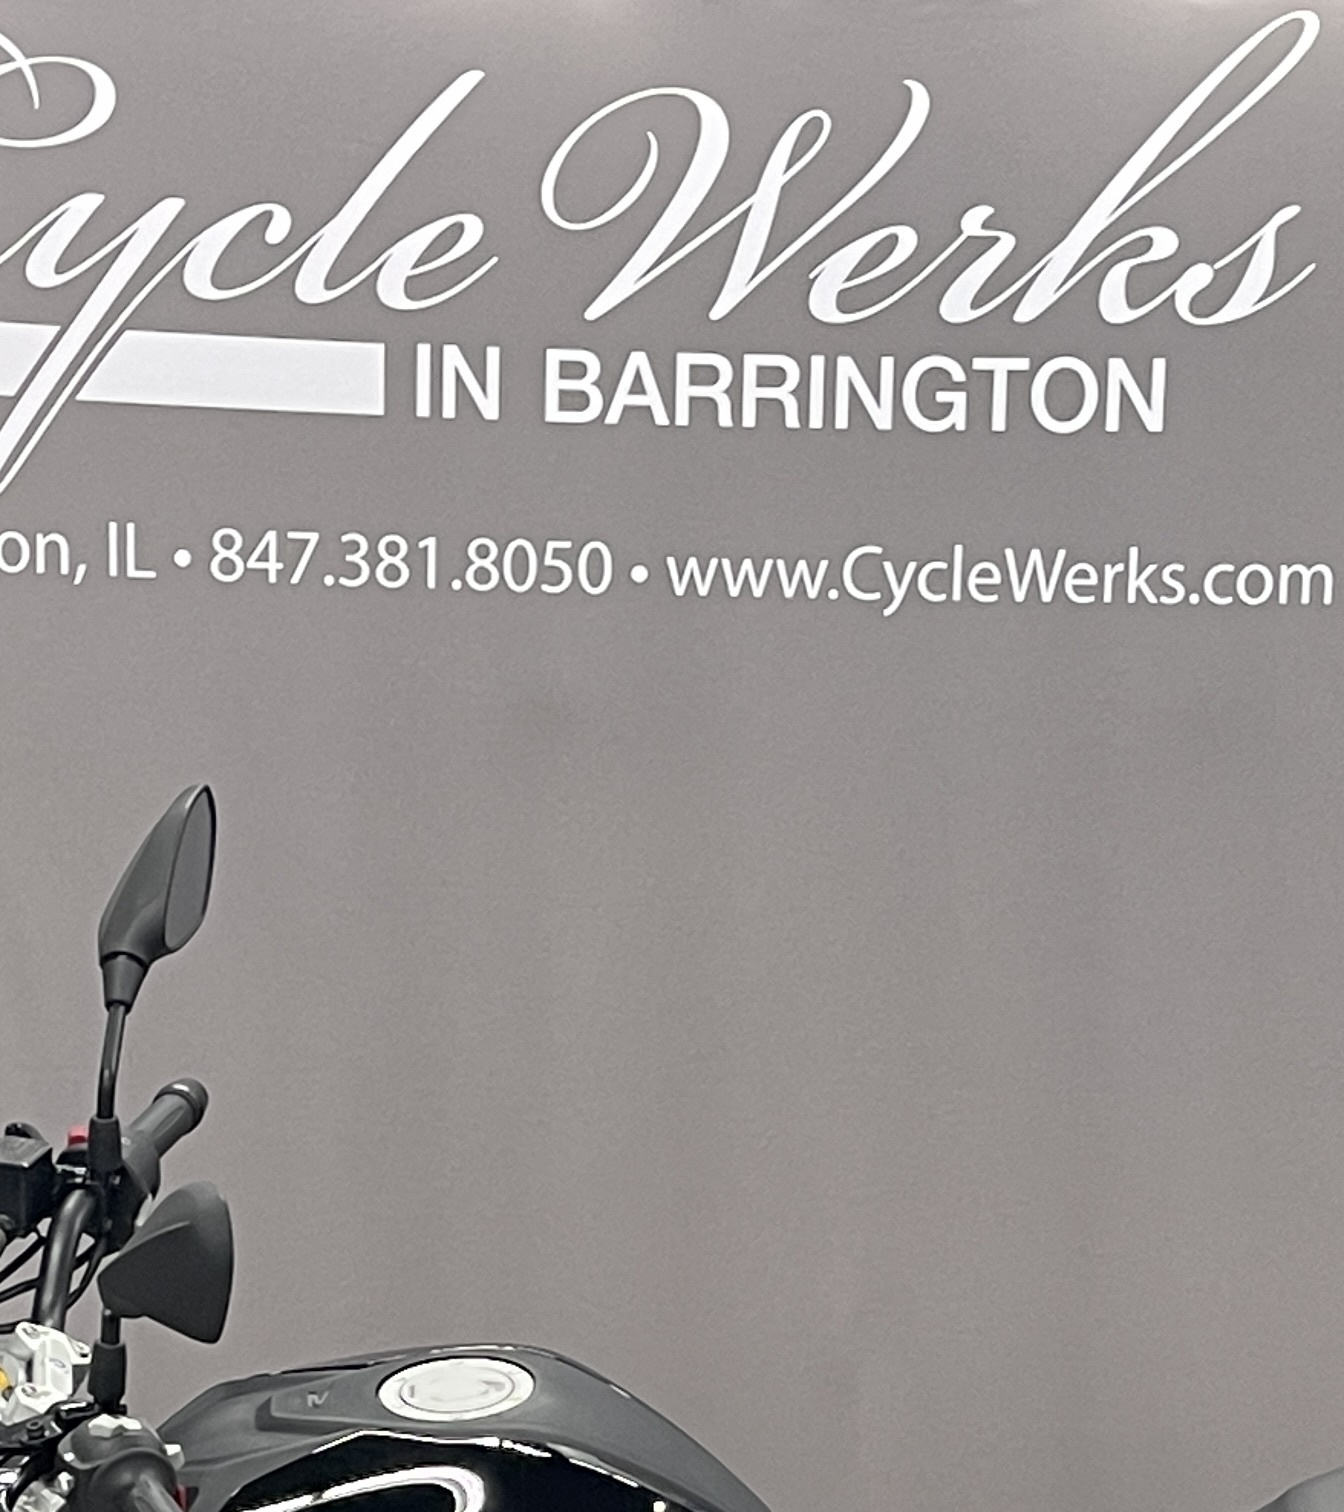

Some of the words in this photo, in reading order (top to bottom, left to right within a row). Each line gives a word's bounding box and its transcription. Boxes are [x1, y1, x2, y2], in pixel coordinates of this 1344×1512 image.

[541, 9, 1322, 326] Werks
[416, 343, 501, 420] IN
[544, 347, 1167, 434] BARRINGTON
[108, 521, 157, 579] IL
[210, 526, 613, 595] 847.381.8050
[666, 544, 1334, 617] www.CycleWerks.com
